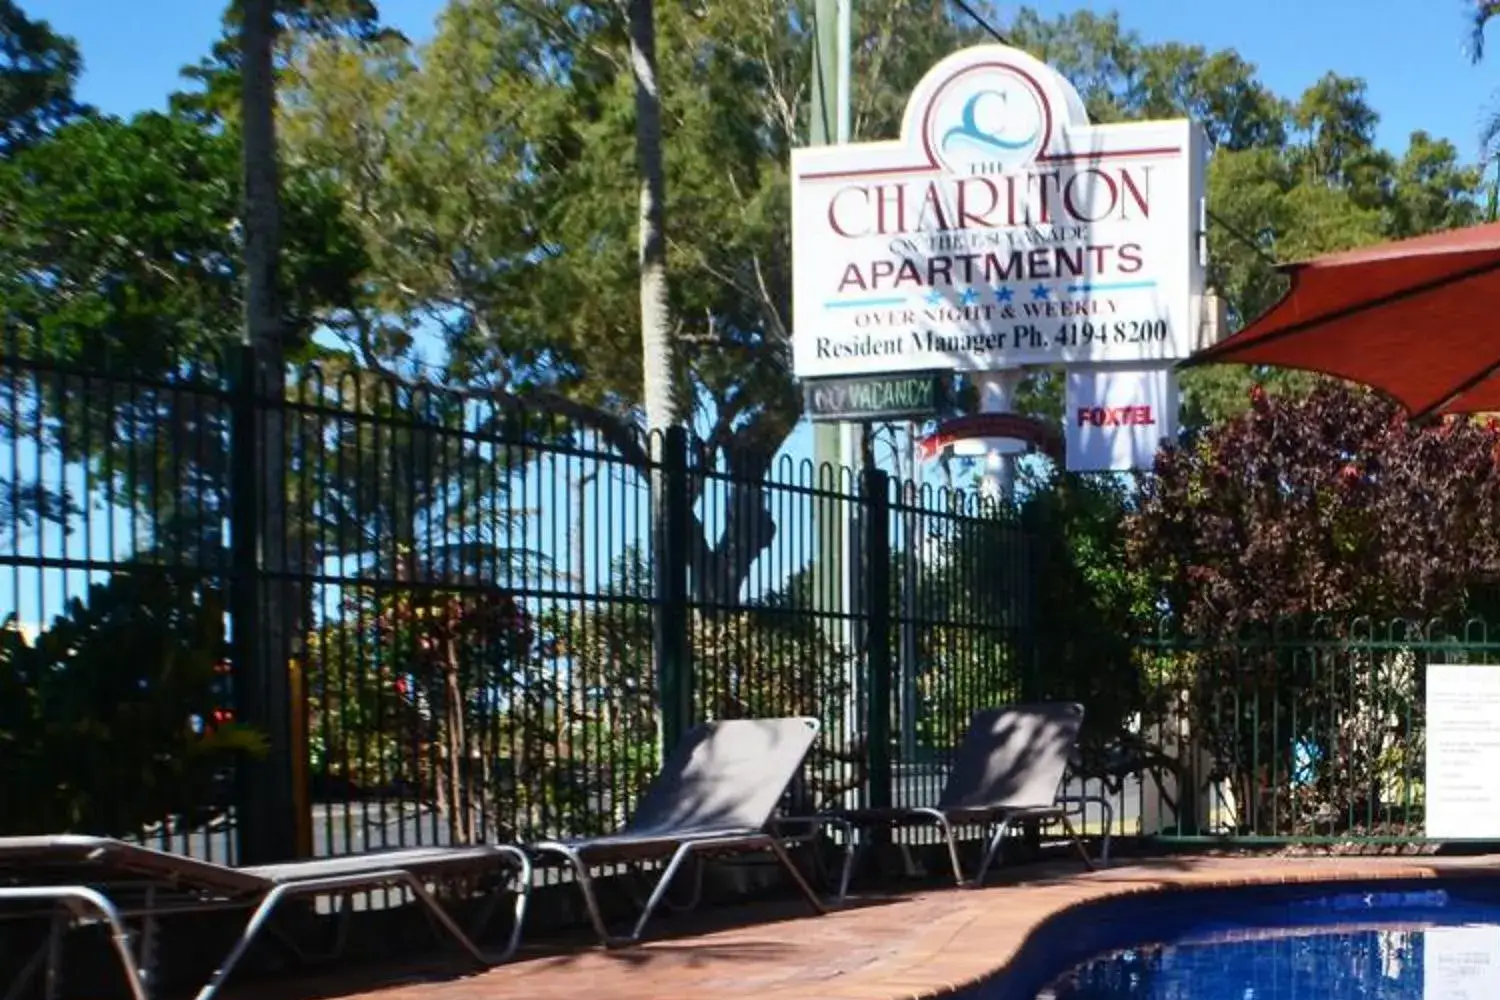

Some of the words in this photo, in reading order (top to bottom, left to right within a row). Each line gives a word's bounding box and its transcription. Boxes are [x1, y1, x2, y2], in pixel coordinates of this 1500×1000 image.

[826, 165, 1152, 239] CHARLTON
[837, 242, 1144, 293] APARTMENTS
[1001, 302, 1015, 320] &
[1023, 299, 1117, 319] WEEKLY
[816, 334, 903, 360] Resident
[911, 329, 1007, 356] Manager
[1013, 323, 1048, 349] Ph.
[1053, 320, 1107, 347] 4194
[1113, 318, 1167, 344] 8200
[848, 378, 933, 410] VACANCY
[1077, 405, 1156, 428] FOXTEL
